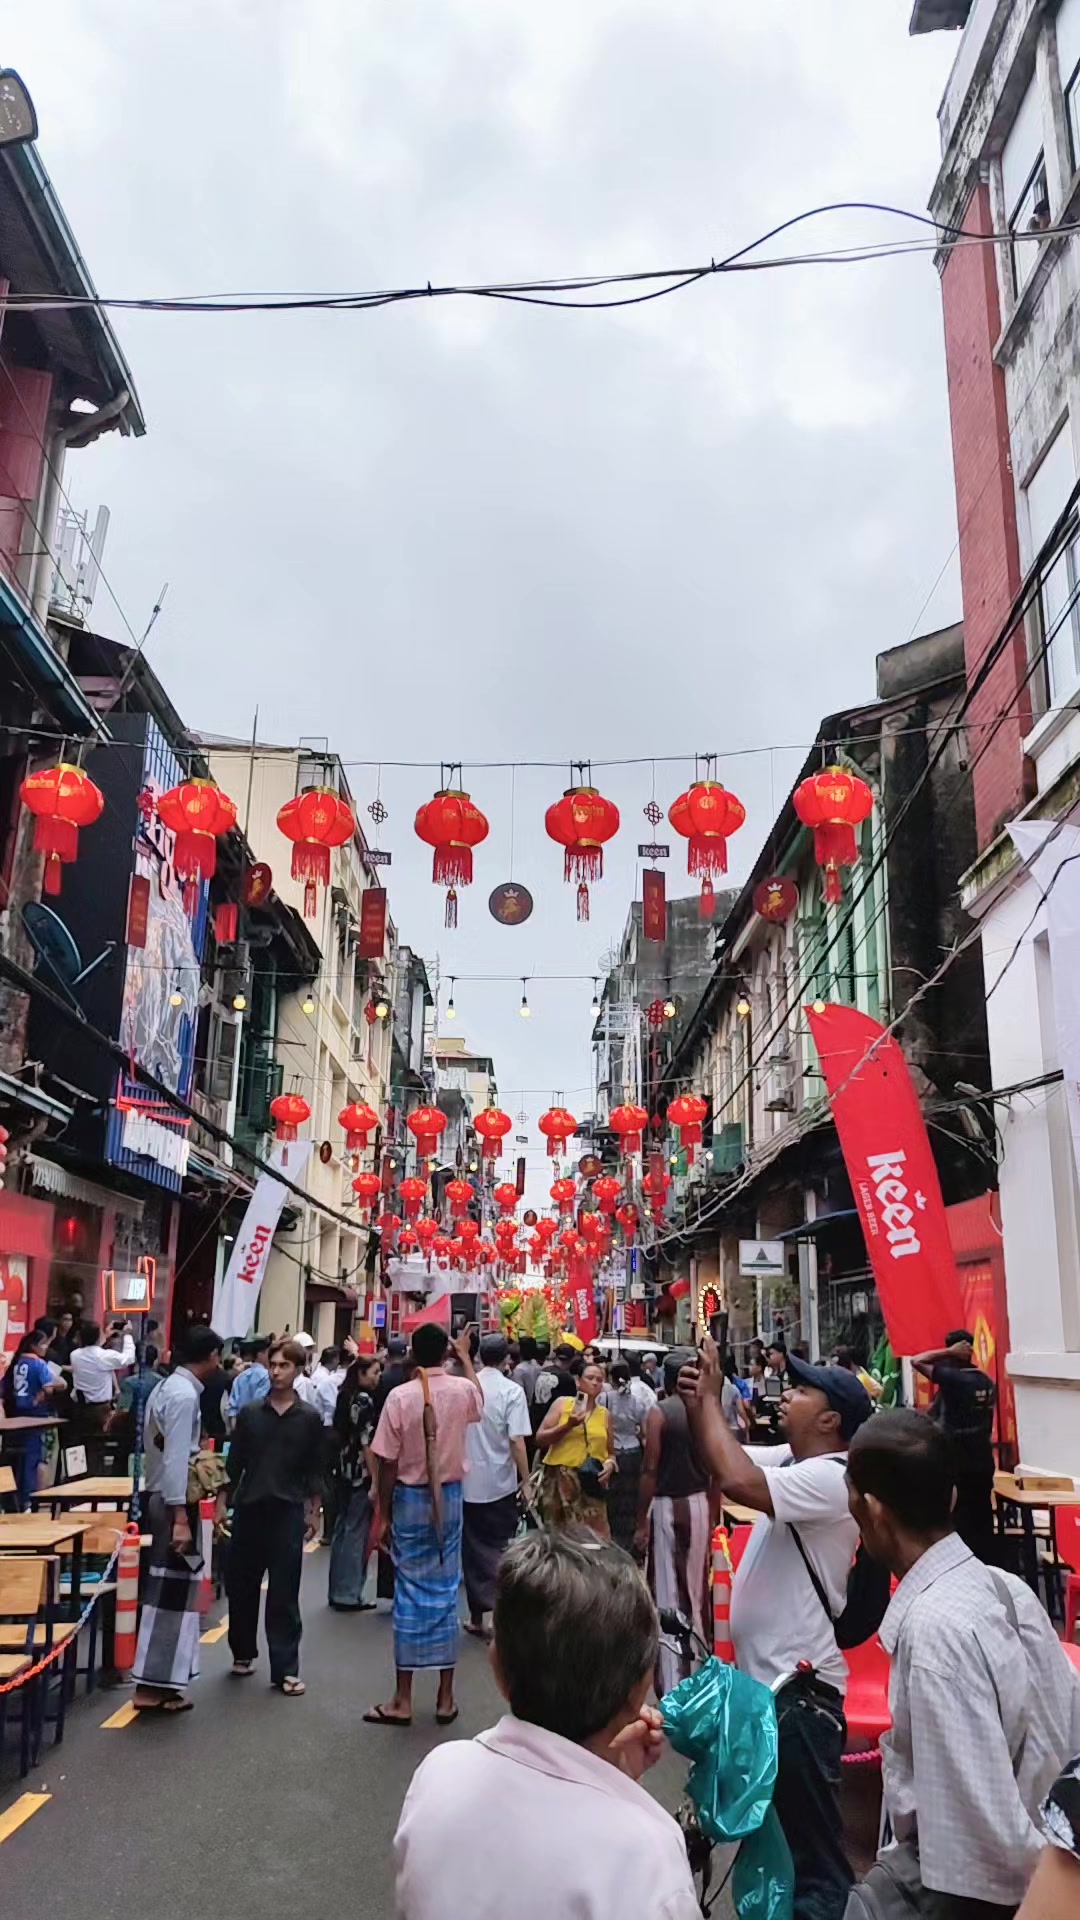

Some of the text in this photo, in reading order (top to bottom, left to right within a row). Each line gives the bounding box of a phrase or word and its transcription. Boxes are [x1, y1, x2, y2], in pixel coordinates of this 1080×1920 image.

[363, 852, 389, 864] keen
[641, 847, 668, 857] keen
[859, 1182, 879, 1236] LAGER BEER
[866, 1149, 921, 1259] keen
[237, 1225, 272, 1284] keen
[576, 1288, 589, 1320] keen
